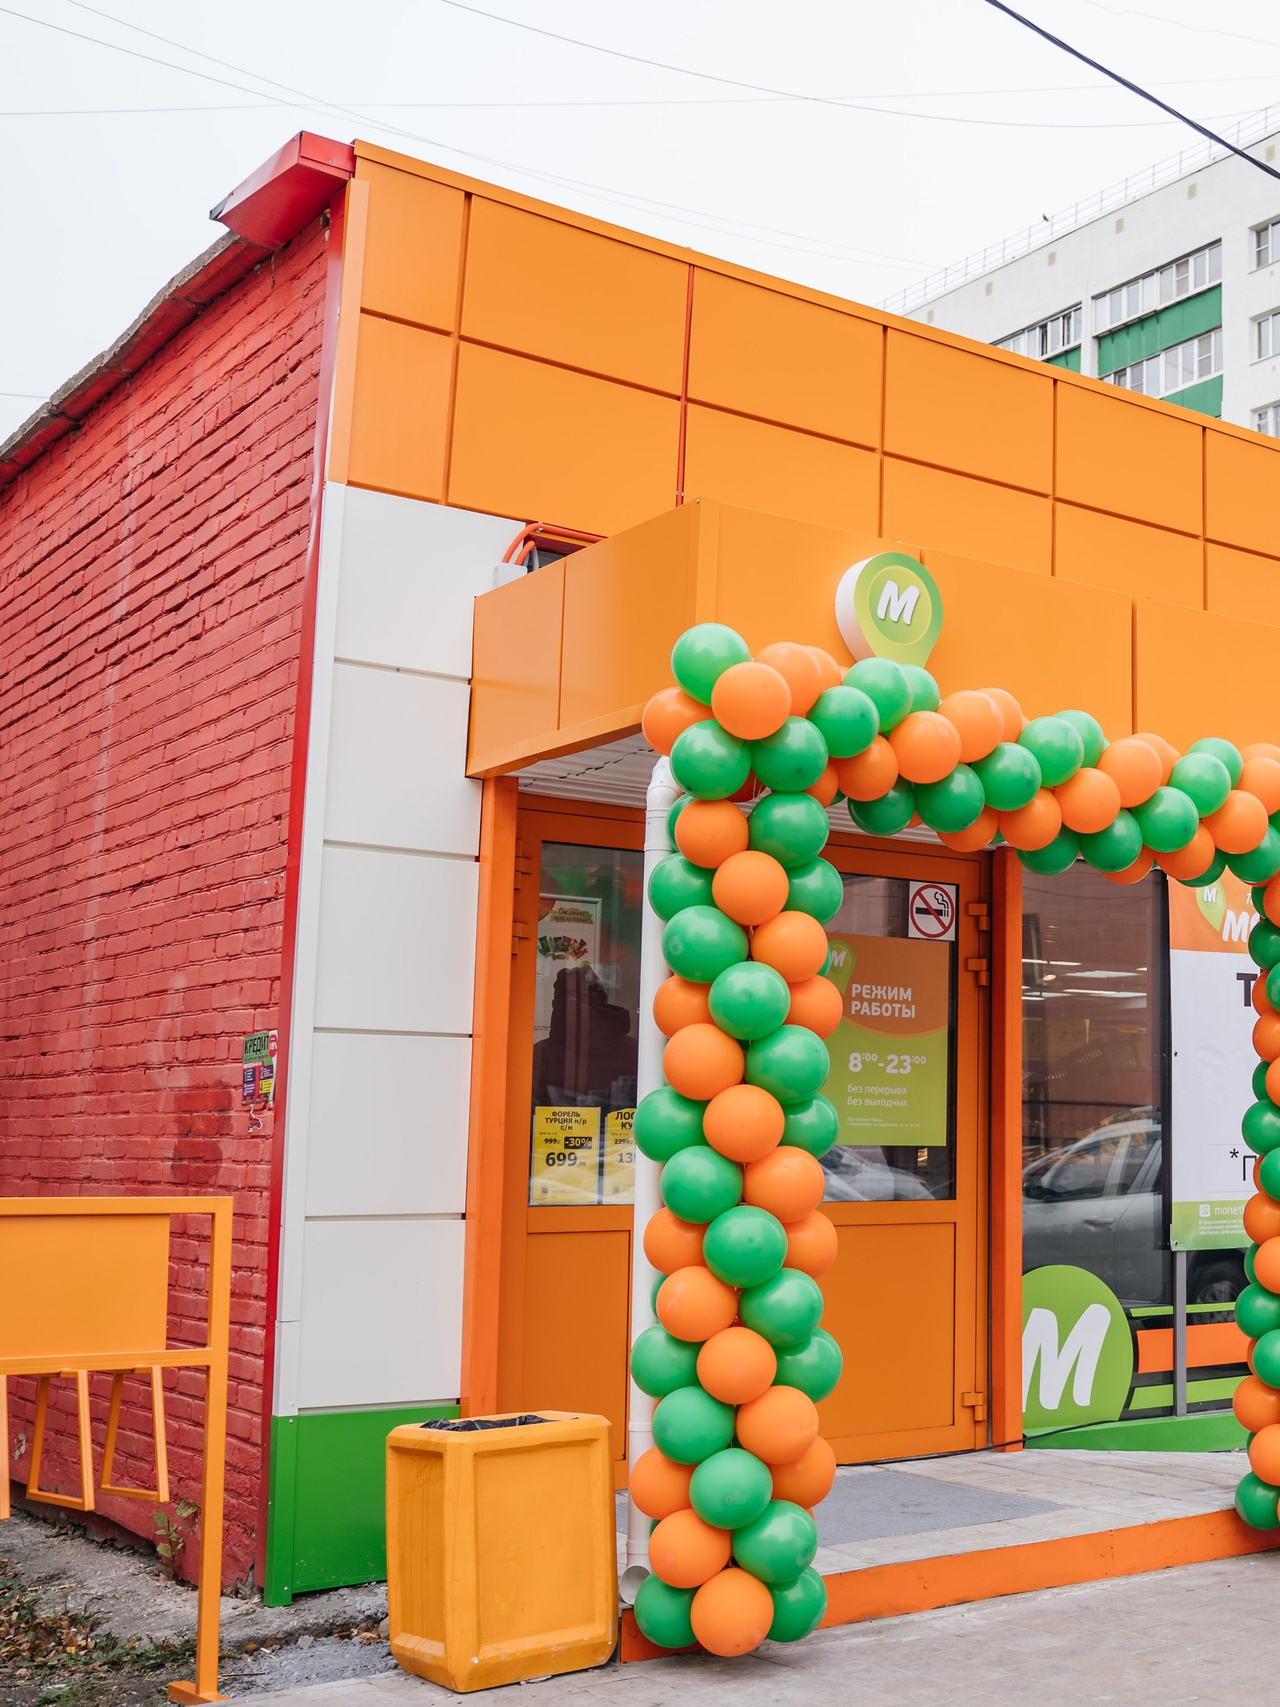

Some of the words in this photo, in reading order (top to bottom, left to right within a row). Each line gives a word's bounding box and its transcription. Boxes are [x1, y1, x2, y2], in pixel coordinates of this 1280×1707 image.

[851, 983, 912, 1001] РЕЖИМ
[851, 1001, 916, 1018] РАБОТЫ
[244, 1034, 269, 1055] КРЕДИТ
[847, 1084, 863, 1094] без
[864, 1086, 907, 1096] перерыва
[847, 1096, 863, 1106] без
[864, 1098, 908, 1108] выходных
[565, 1137, 592, 1148] -30%
